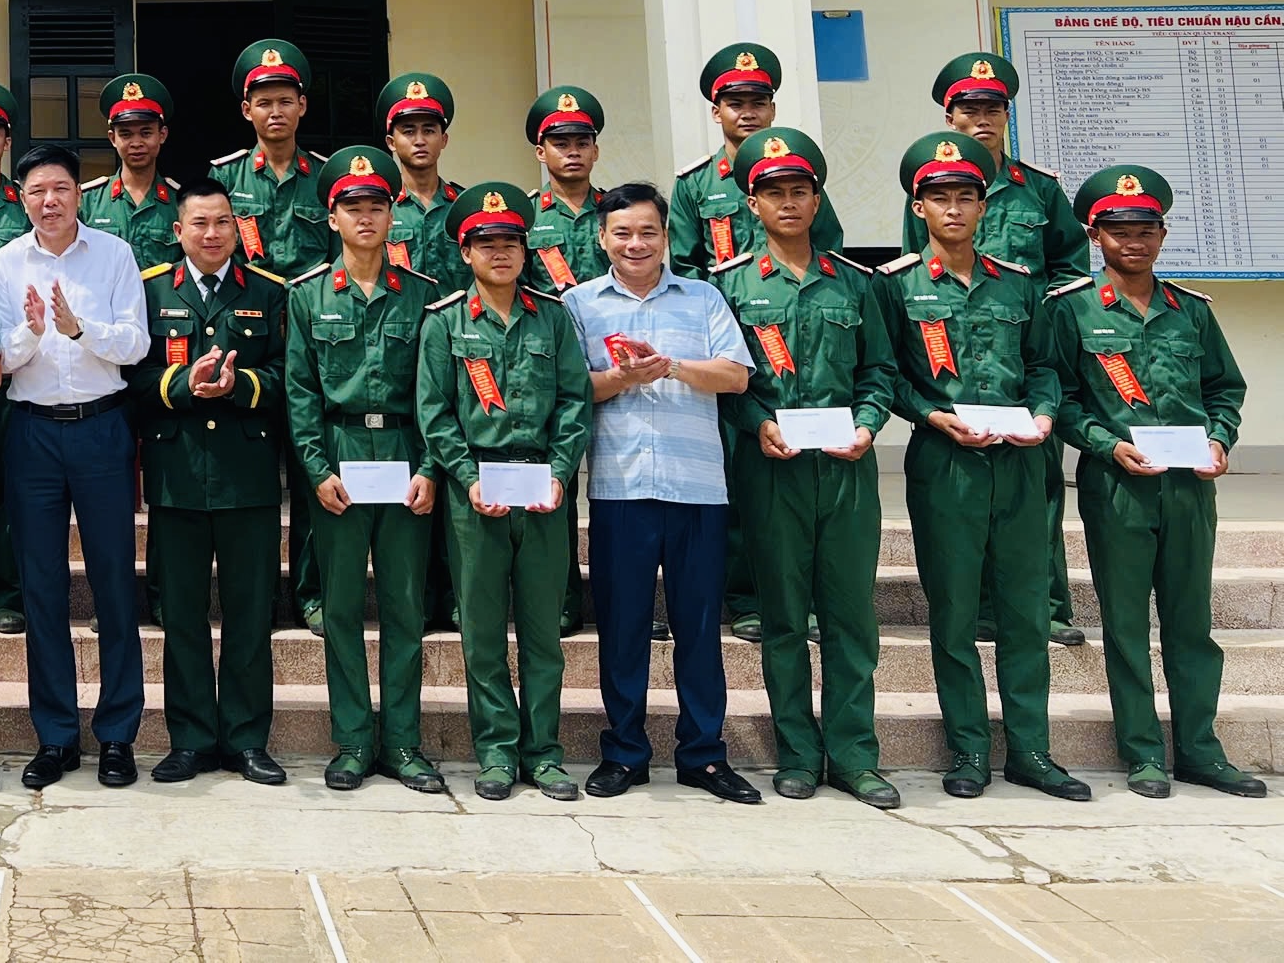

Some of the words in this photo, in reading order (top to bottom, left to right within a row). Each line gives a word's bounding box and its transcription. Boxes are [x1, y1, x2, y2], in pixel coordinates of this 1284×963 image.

[1055, 16, 1090, 27] BẢNG
[1094, 15, 1117, 27] CHẾ
[1146, 16, 1174, 27] TIÊU
[1178, 14, 1222, 26] CHUẨN
[1225, 15, 1251, 28] HẬU
